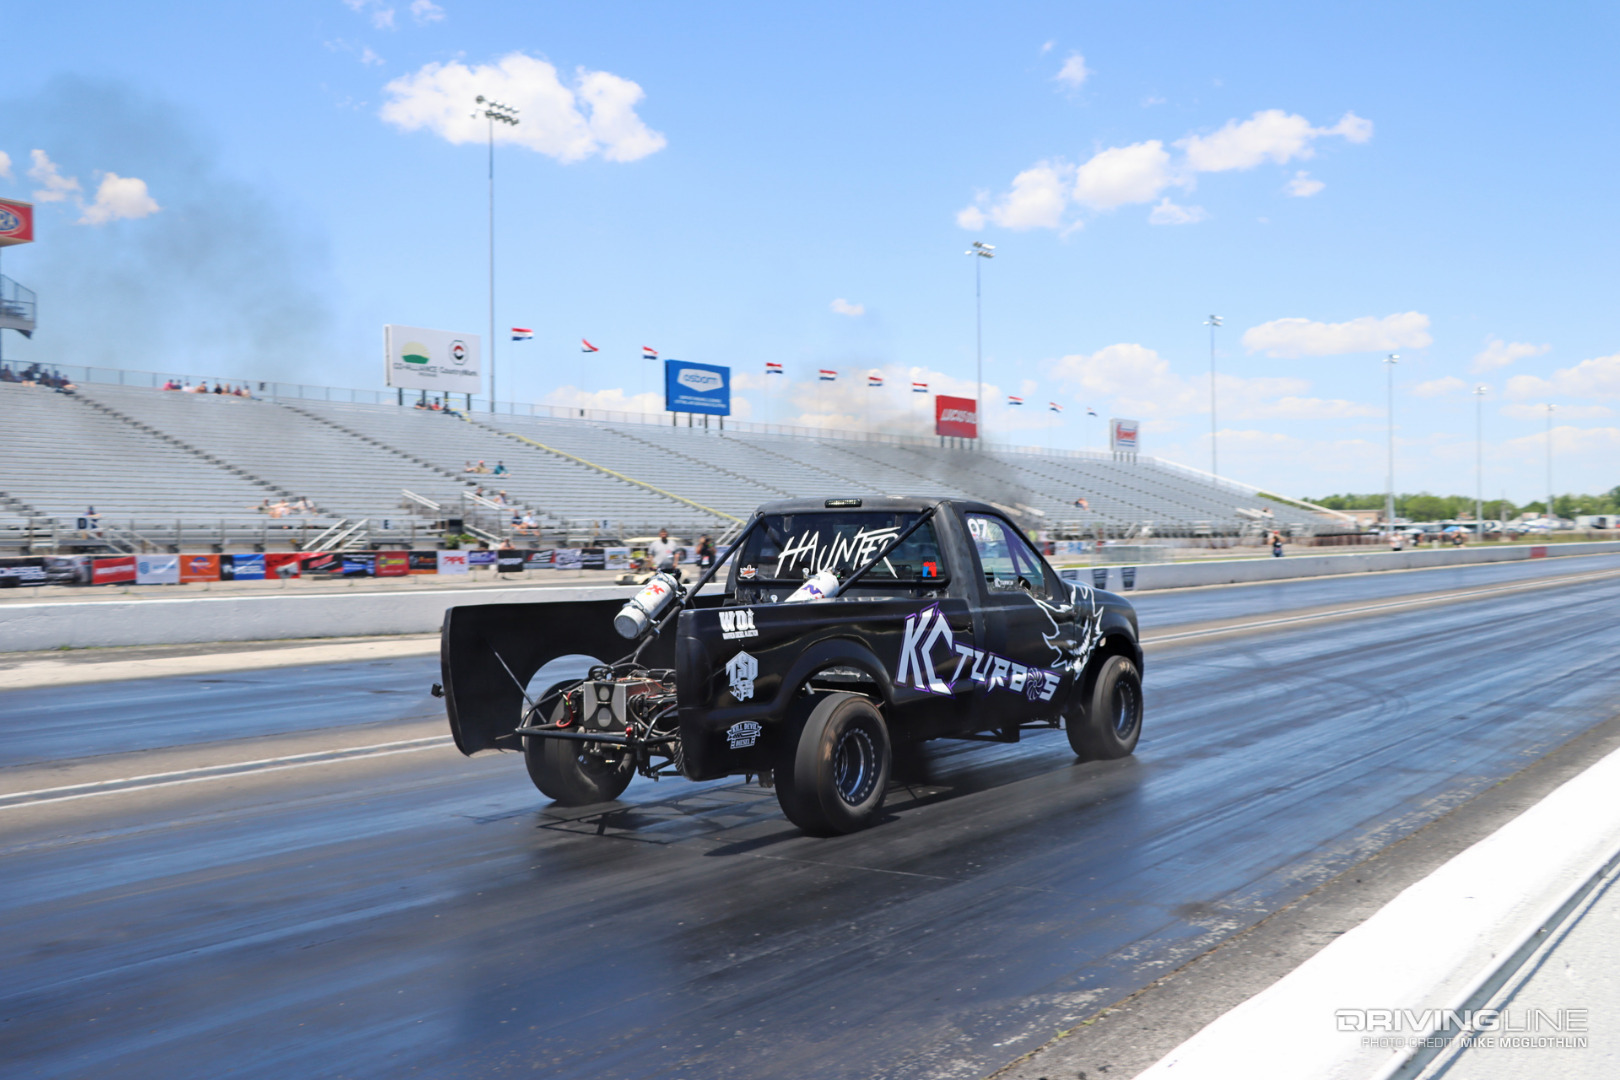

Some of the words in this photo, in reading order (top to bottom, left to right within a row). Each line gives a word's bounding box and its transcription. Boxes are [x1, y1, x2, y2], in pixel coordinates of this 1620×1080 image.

[774, 525, 902, 579] HAUNTER
[896, 604, 954, 697] KC
[950, 641, 1061, 702] TURBOS
